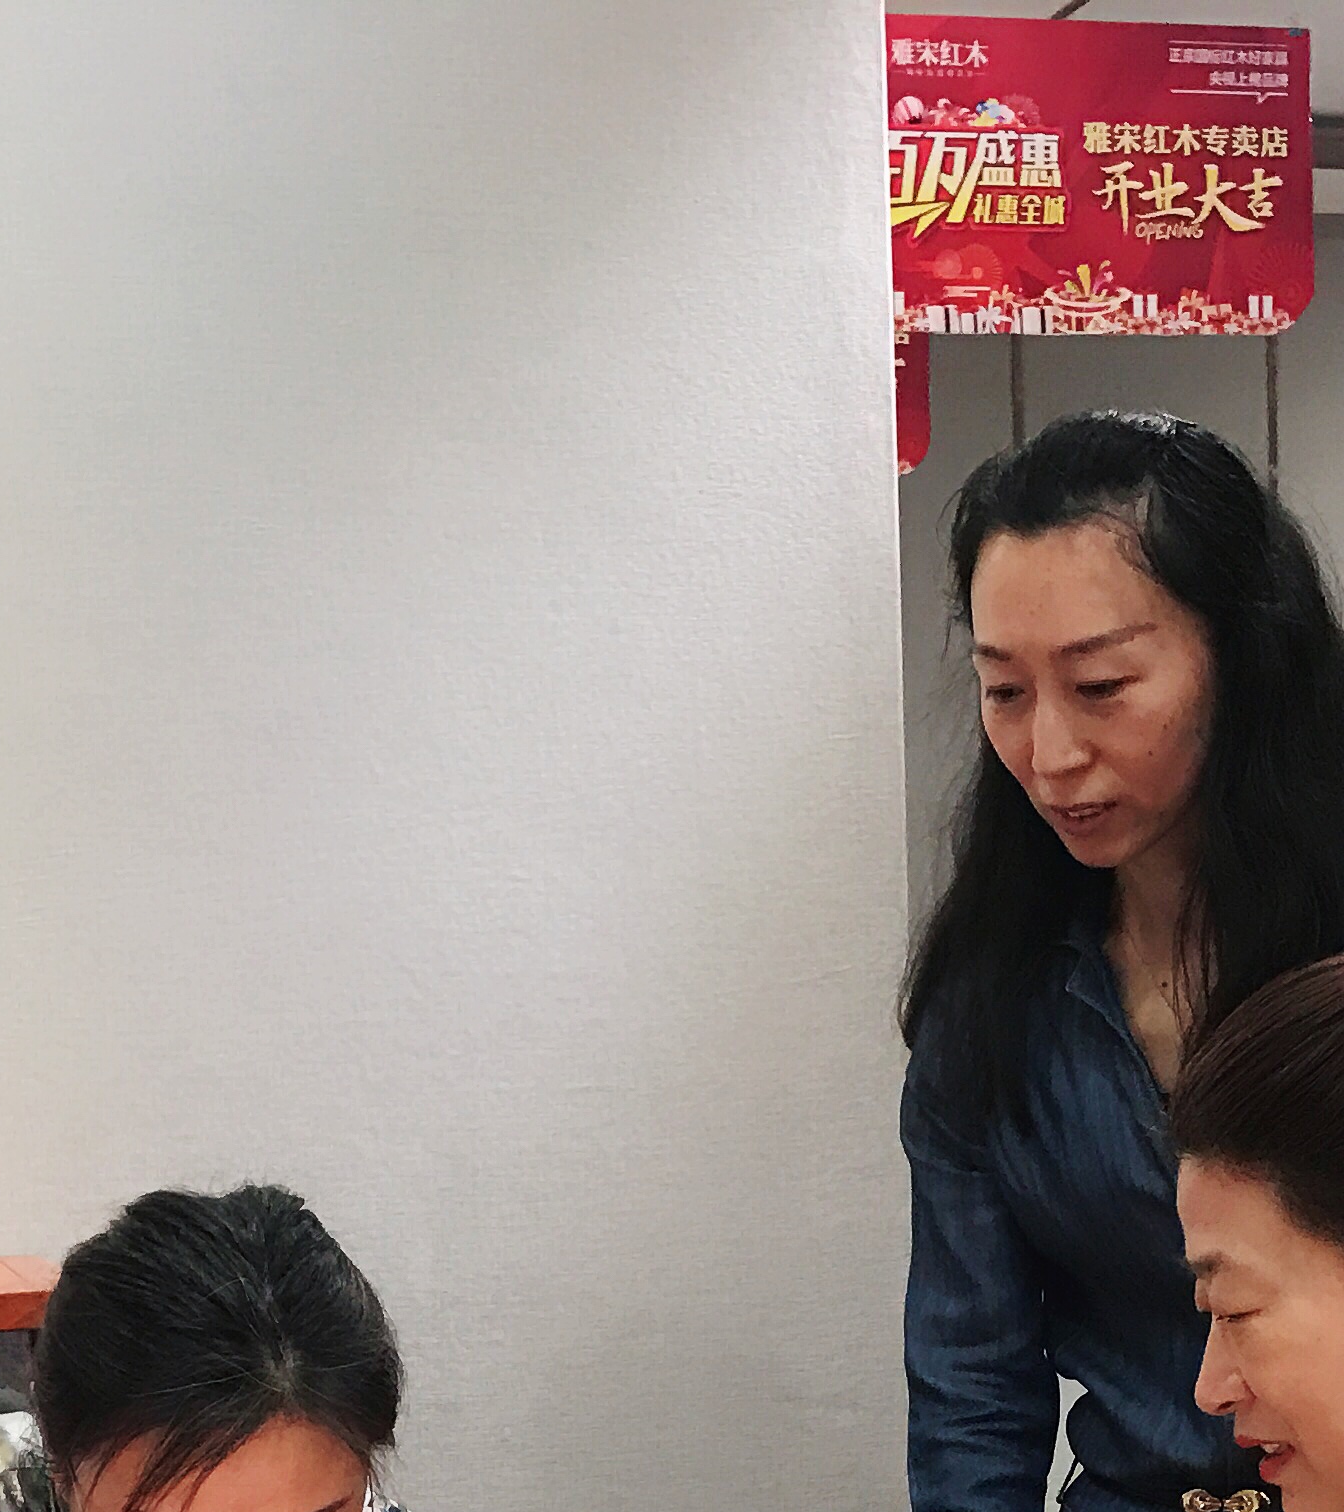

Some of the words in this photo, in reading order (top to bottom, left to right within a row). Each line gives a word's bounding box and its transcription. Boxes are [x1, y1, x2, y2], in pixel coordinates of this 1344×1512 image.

[891, 38, 989, 67] 雅宋红木
[1083, 121, 1289, 159] 雅宋红木专卖店
[972, 193, 1067, 225] 礼惠全城
[1092, 161, 1285, 236] 开业大吉
[1134, 220, 1204, 245] OPENING
